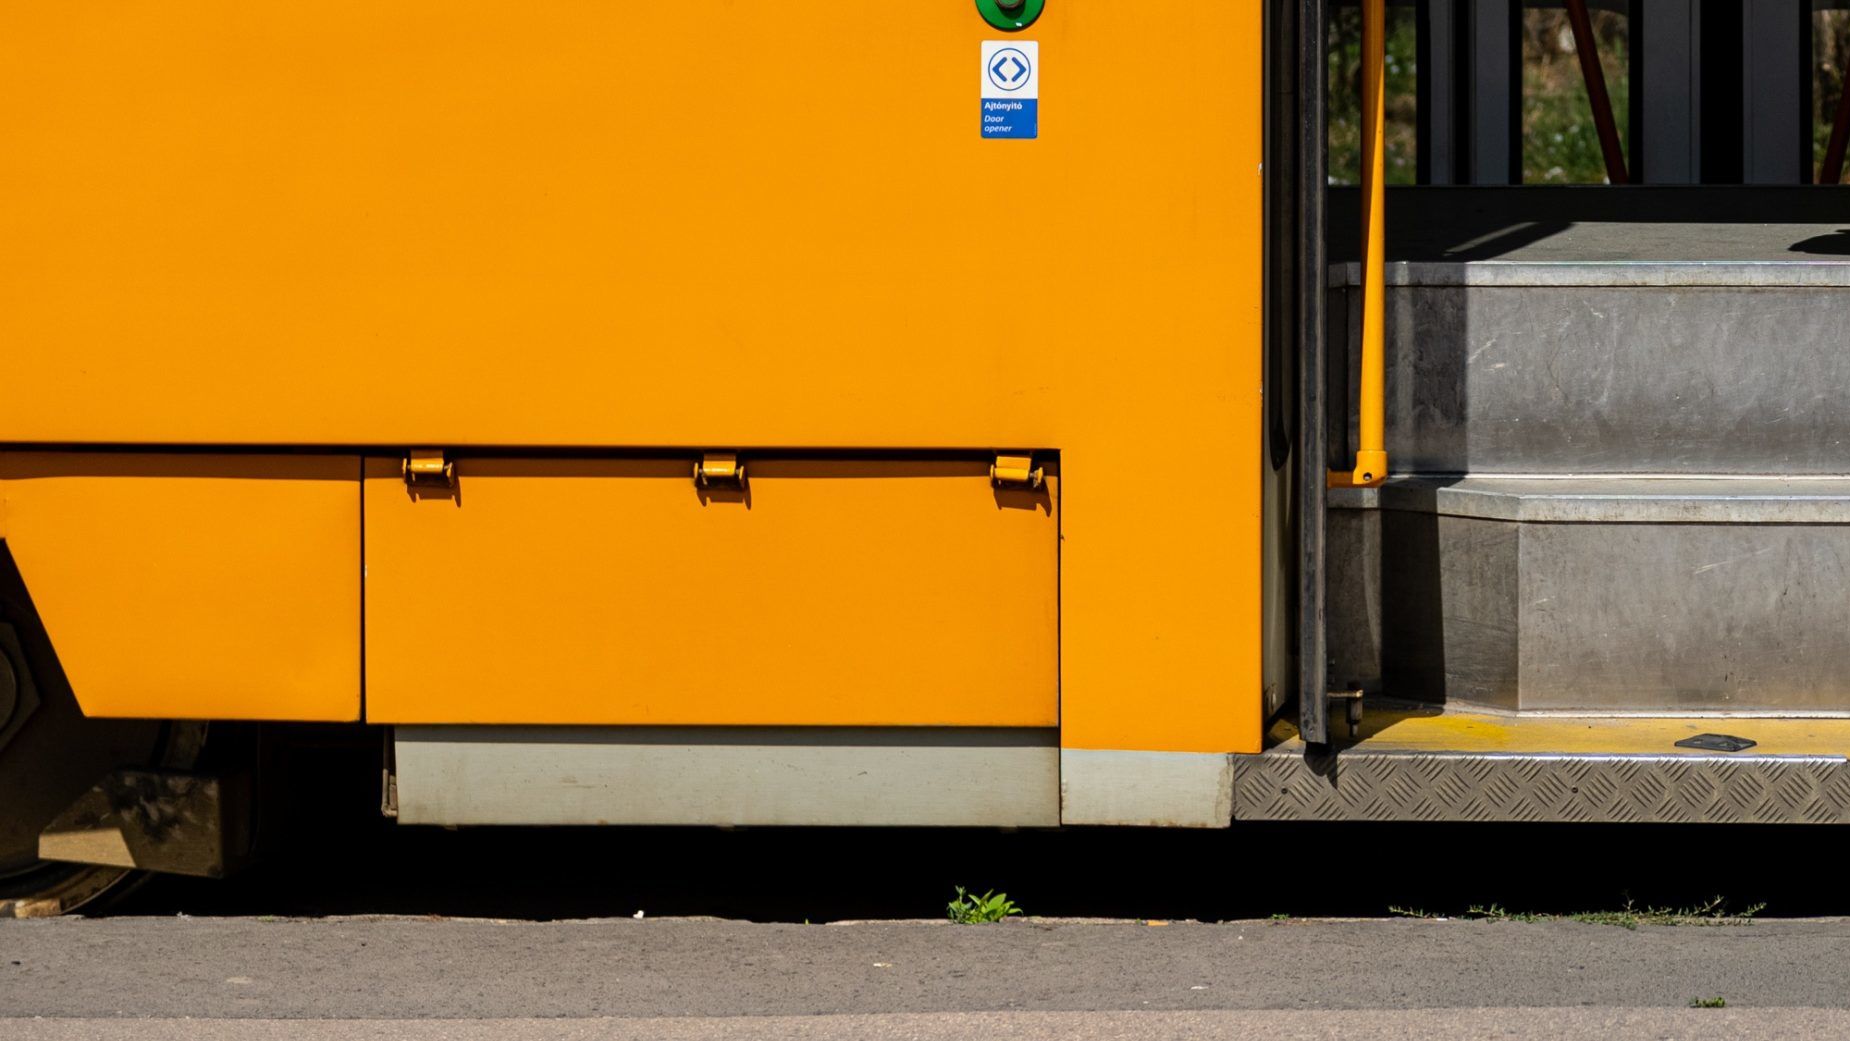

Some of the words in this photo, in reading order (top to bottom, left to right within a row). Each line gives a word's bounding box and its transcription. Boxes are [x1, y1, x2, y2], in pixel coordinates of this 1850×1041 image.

[984, 102, 1023, 111] Ajtónyitó
[984, 115, 1004, 123] Door
[984, 125, 1012, 133] opener
